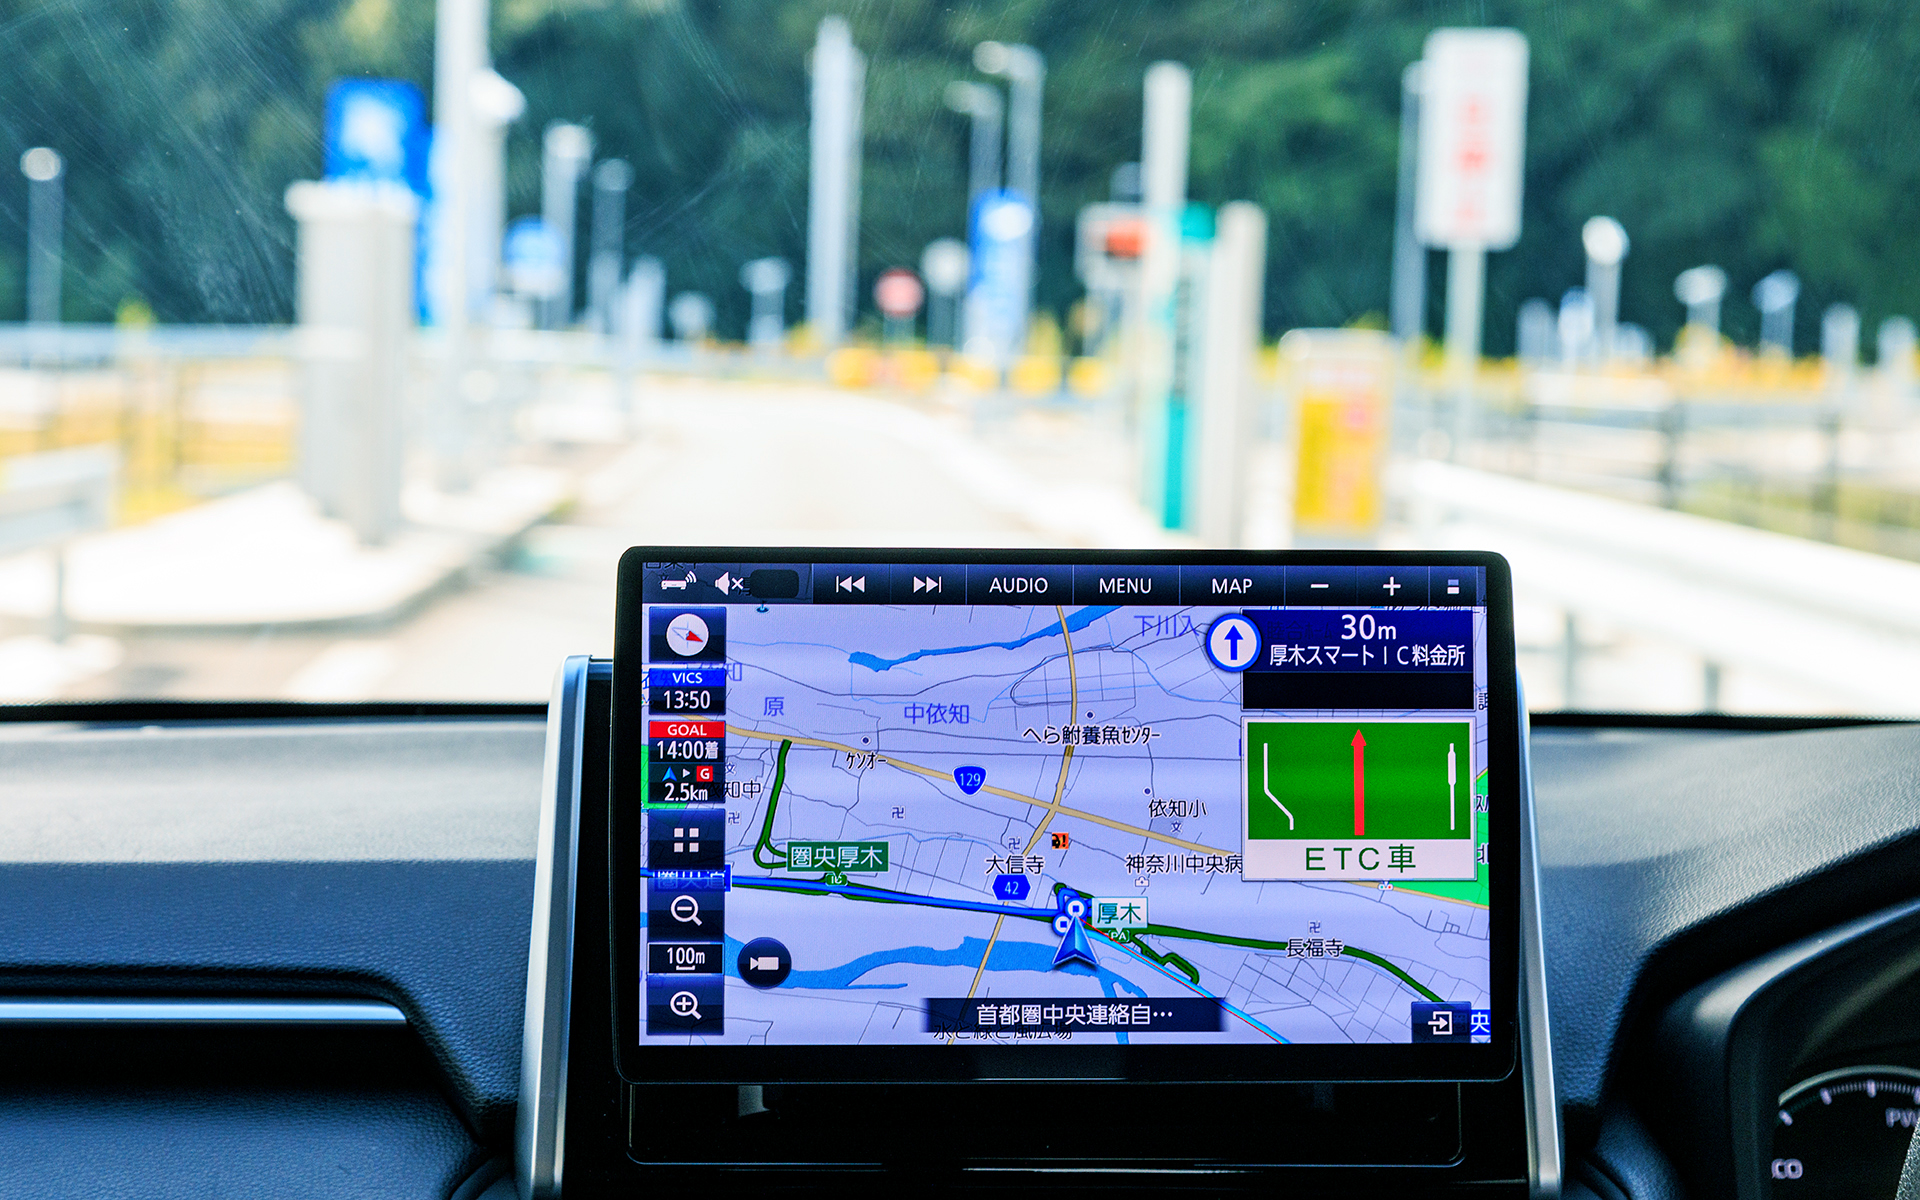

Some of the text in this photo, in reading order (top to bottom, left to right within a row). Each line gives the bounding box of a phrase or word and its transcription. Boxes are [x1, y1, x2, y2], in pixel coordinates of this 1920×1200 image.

[989, 577, 1048, 594] AUDIO
[1099, 578, 1152, 594] MENU
[1211, 578, 1252, 594] MAP
[1133, 615, 1200, 637] 下川入
[1341, 614, 1397, 640] 30m
[672, 672, 703, 684] VICS
[664, 690, 711, 709] 13:50
[763, 697, 786, 717] 原
[904, 703, 970, 724] 中依知
[667, 725, 707, 736] GOAL
[657, 741, 719, 760] 14:00着
[700, 769, 710, 780] G
[959, 773, 981, 787] 129
[664, 783, 708, 801] 2.5km
[1149, 799, 1208, 818] 依知小
[791, 846, 883, 869] 圏央厚木
[986, 855, 1044, 875] 大信寺
[1306, 844, 1416, 873] ETC車
[1004, 881, 1019, 895] 42
[1097, 903, 1142, 924] 厚木
[667, 947, 705, 965] 100m
[1287, 938, 1343, 958] 長福寺
